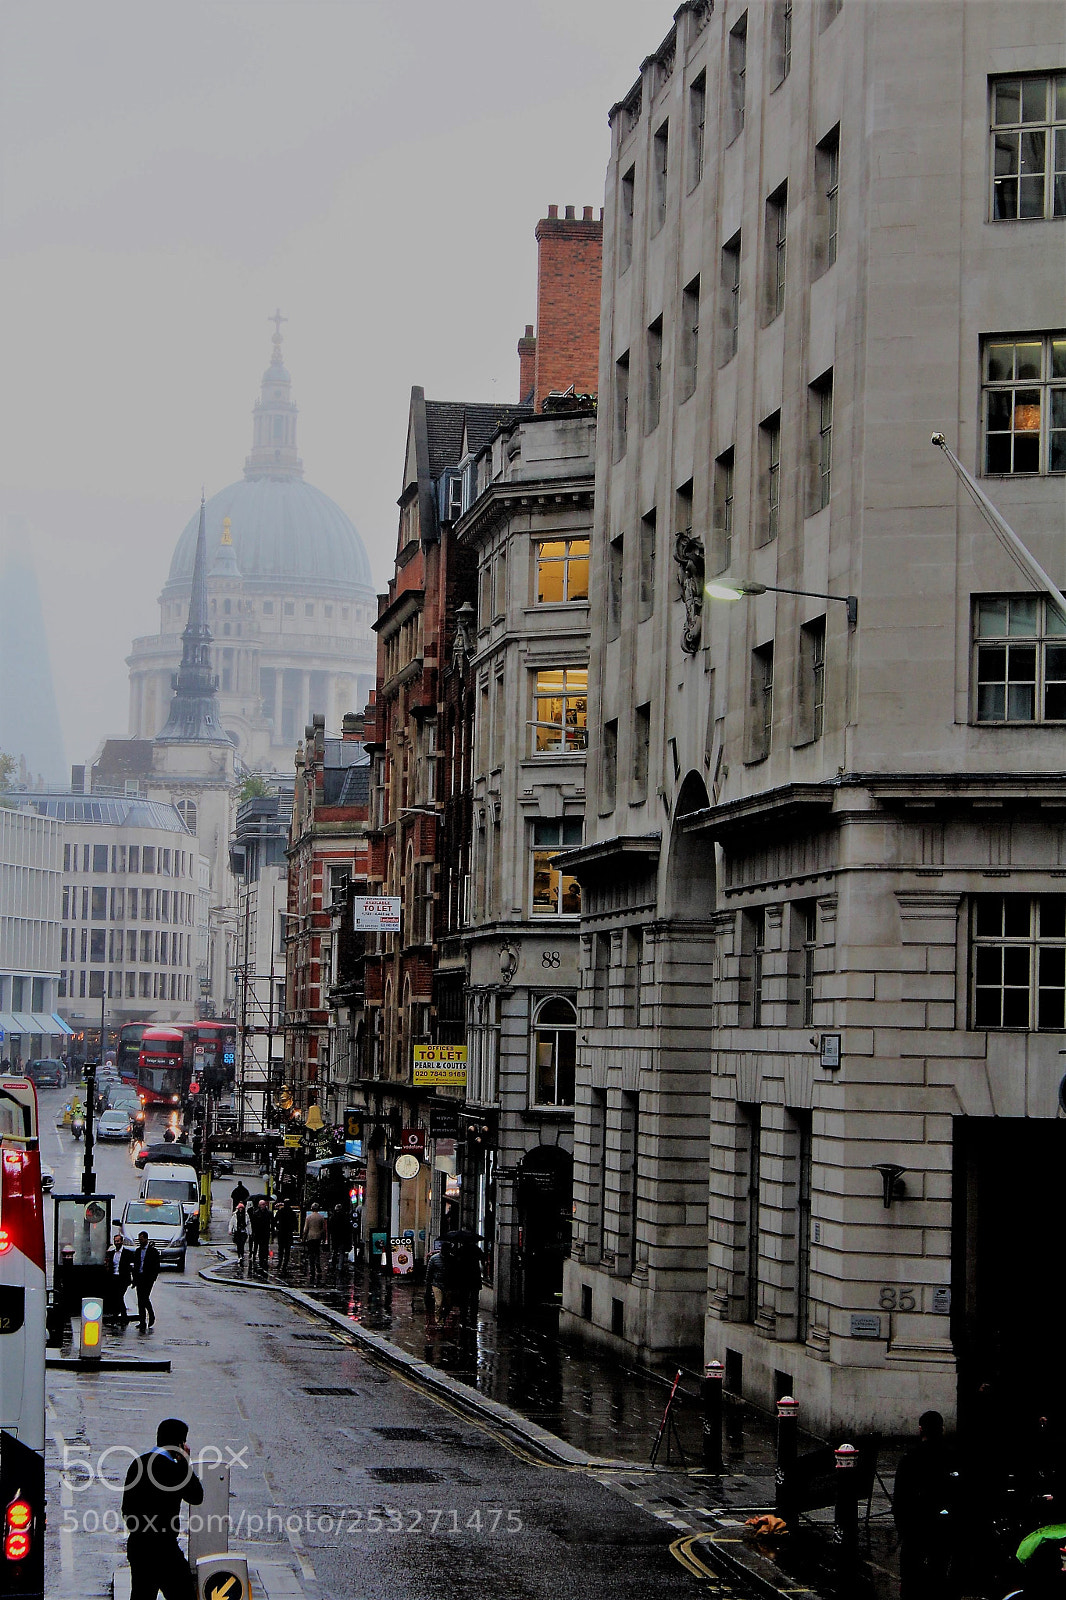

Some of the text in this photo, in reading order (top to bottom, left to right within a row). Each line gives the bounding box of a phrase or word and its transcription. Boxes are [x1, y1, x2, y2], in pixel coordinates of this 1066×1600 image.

[541, 951, 561, 969] 88
[418, 1050, 463, 1060] TO LET
[442, 1062, 467, 1070] COUTTS
[879, 1286, 916, 1311] 85
